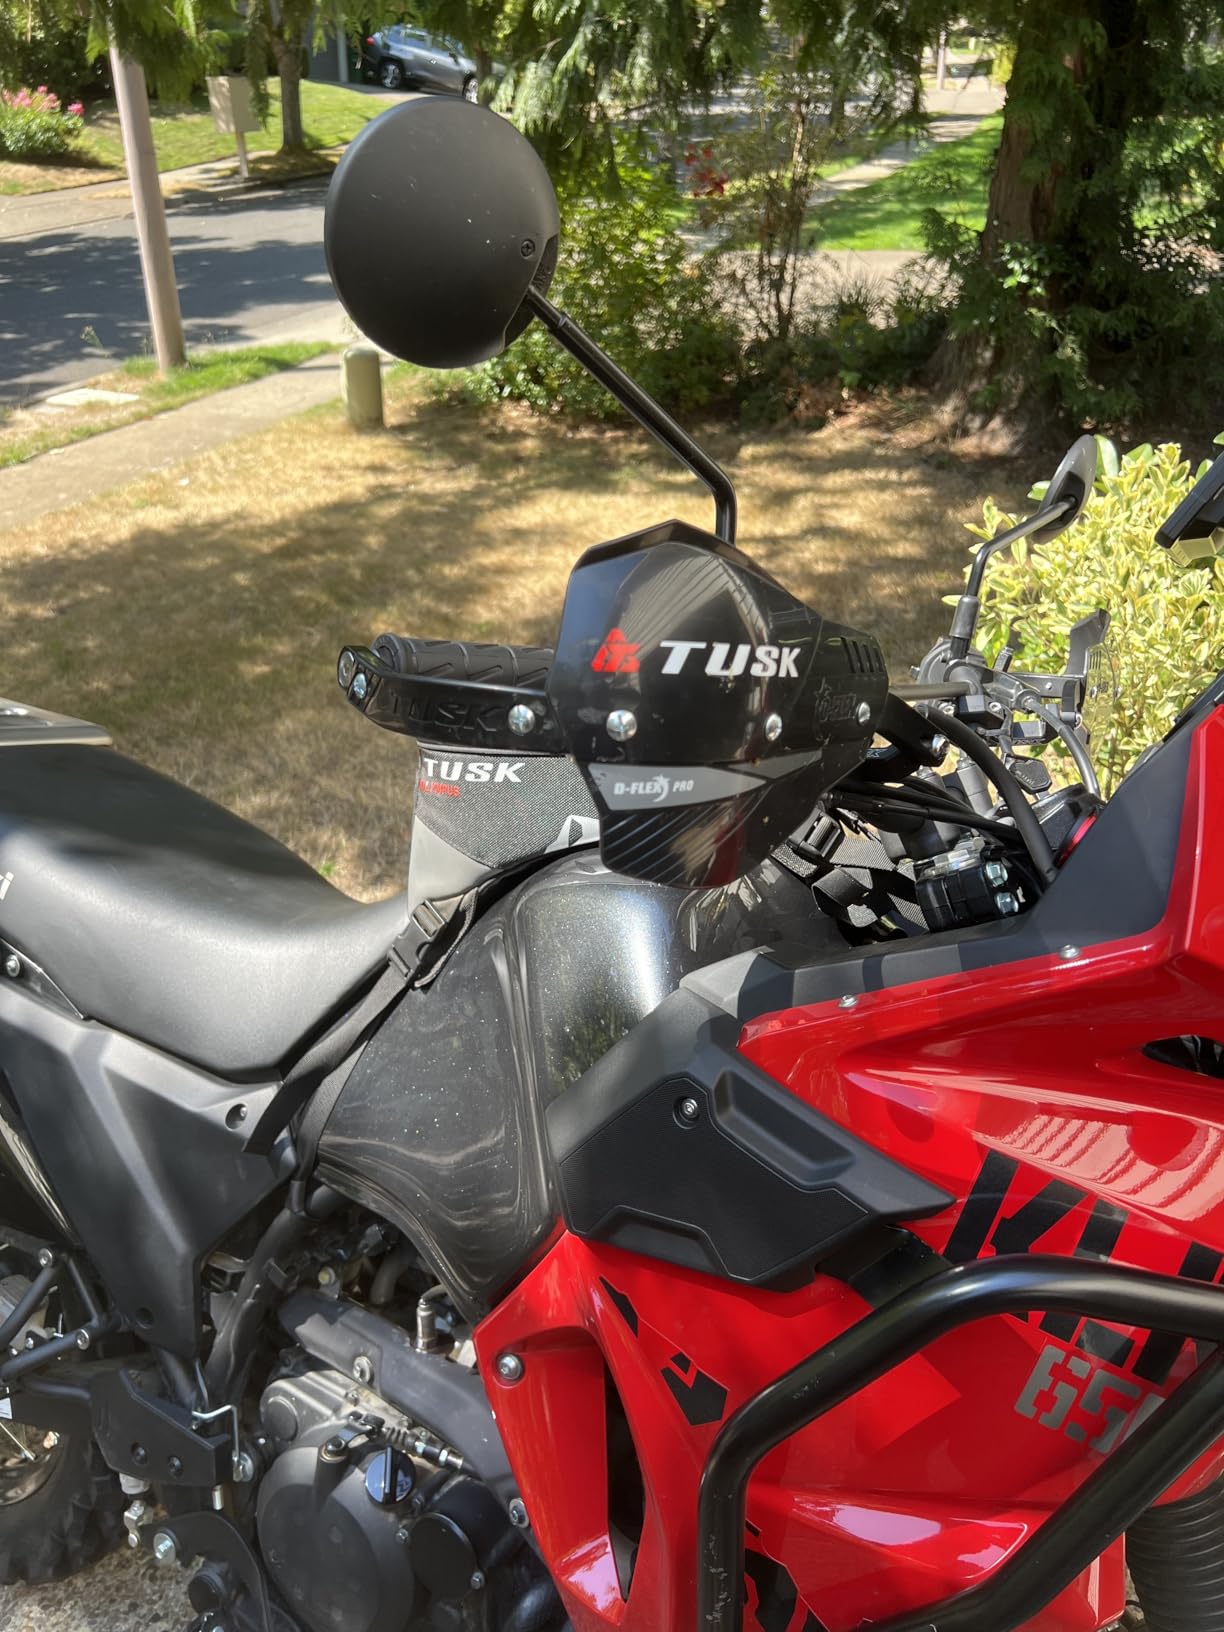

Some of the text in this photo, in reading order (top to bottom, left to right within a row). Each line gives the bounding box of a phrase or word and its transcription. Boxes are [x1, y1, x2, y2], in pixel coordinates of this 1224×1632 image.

[660, 640, 801, 677] TUSK
[423, 757, 526, 783] TUSK
[672, 780, 695, 793] PRO
